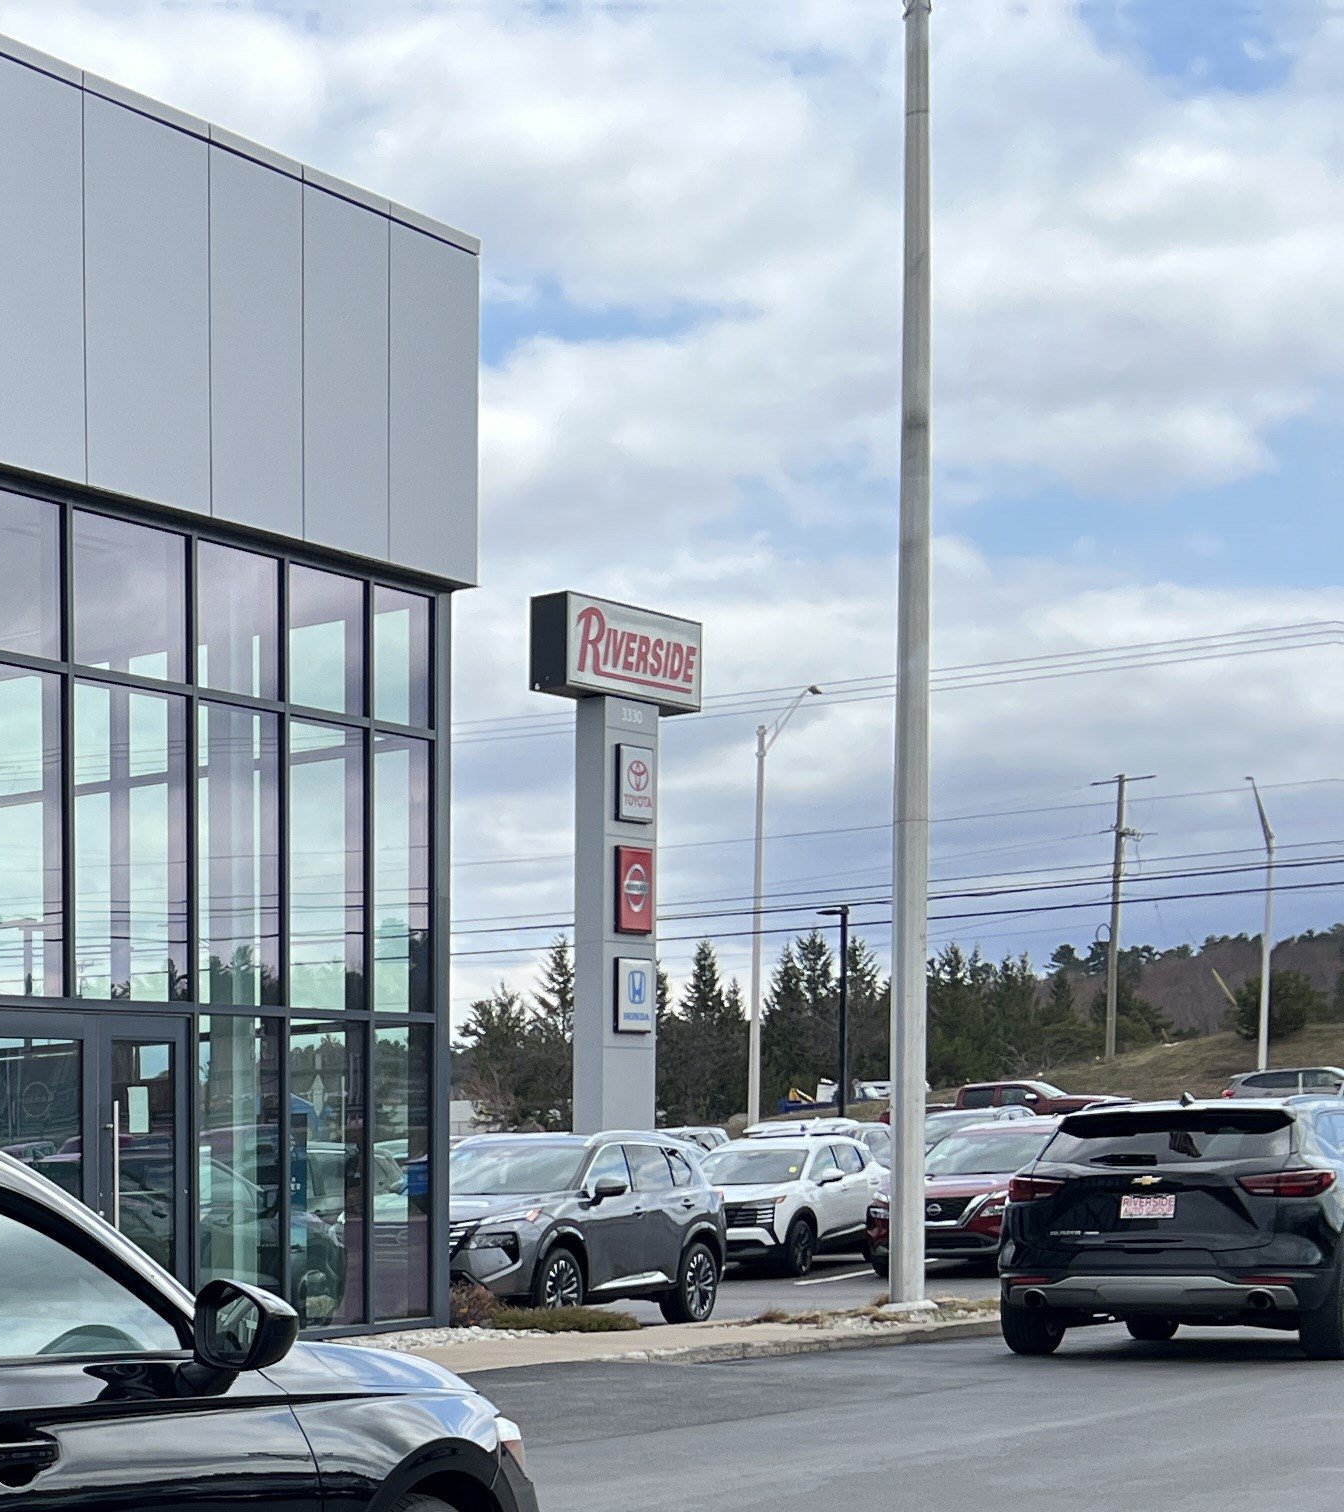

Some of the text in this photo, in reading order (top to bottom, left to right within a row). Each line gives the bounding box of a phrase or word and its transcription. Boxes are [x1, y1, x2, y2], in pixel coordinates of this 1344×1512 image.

[621, 706, 643, 725] 3330
[623, 794, 652, 809] TOYOTA
[623, 1011, 650, 1022] HONDA
[1123, 1197, 1175, 1208] RIVERSIDE
